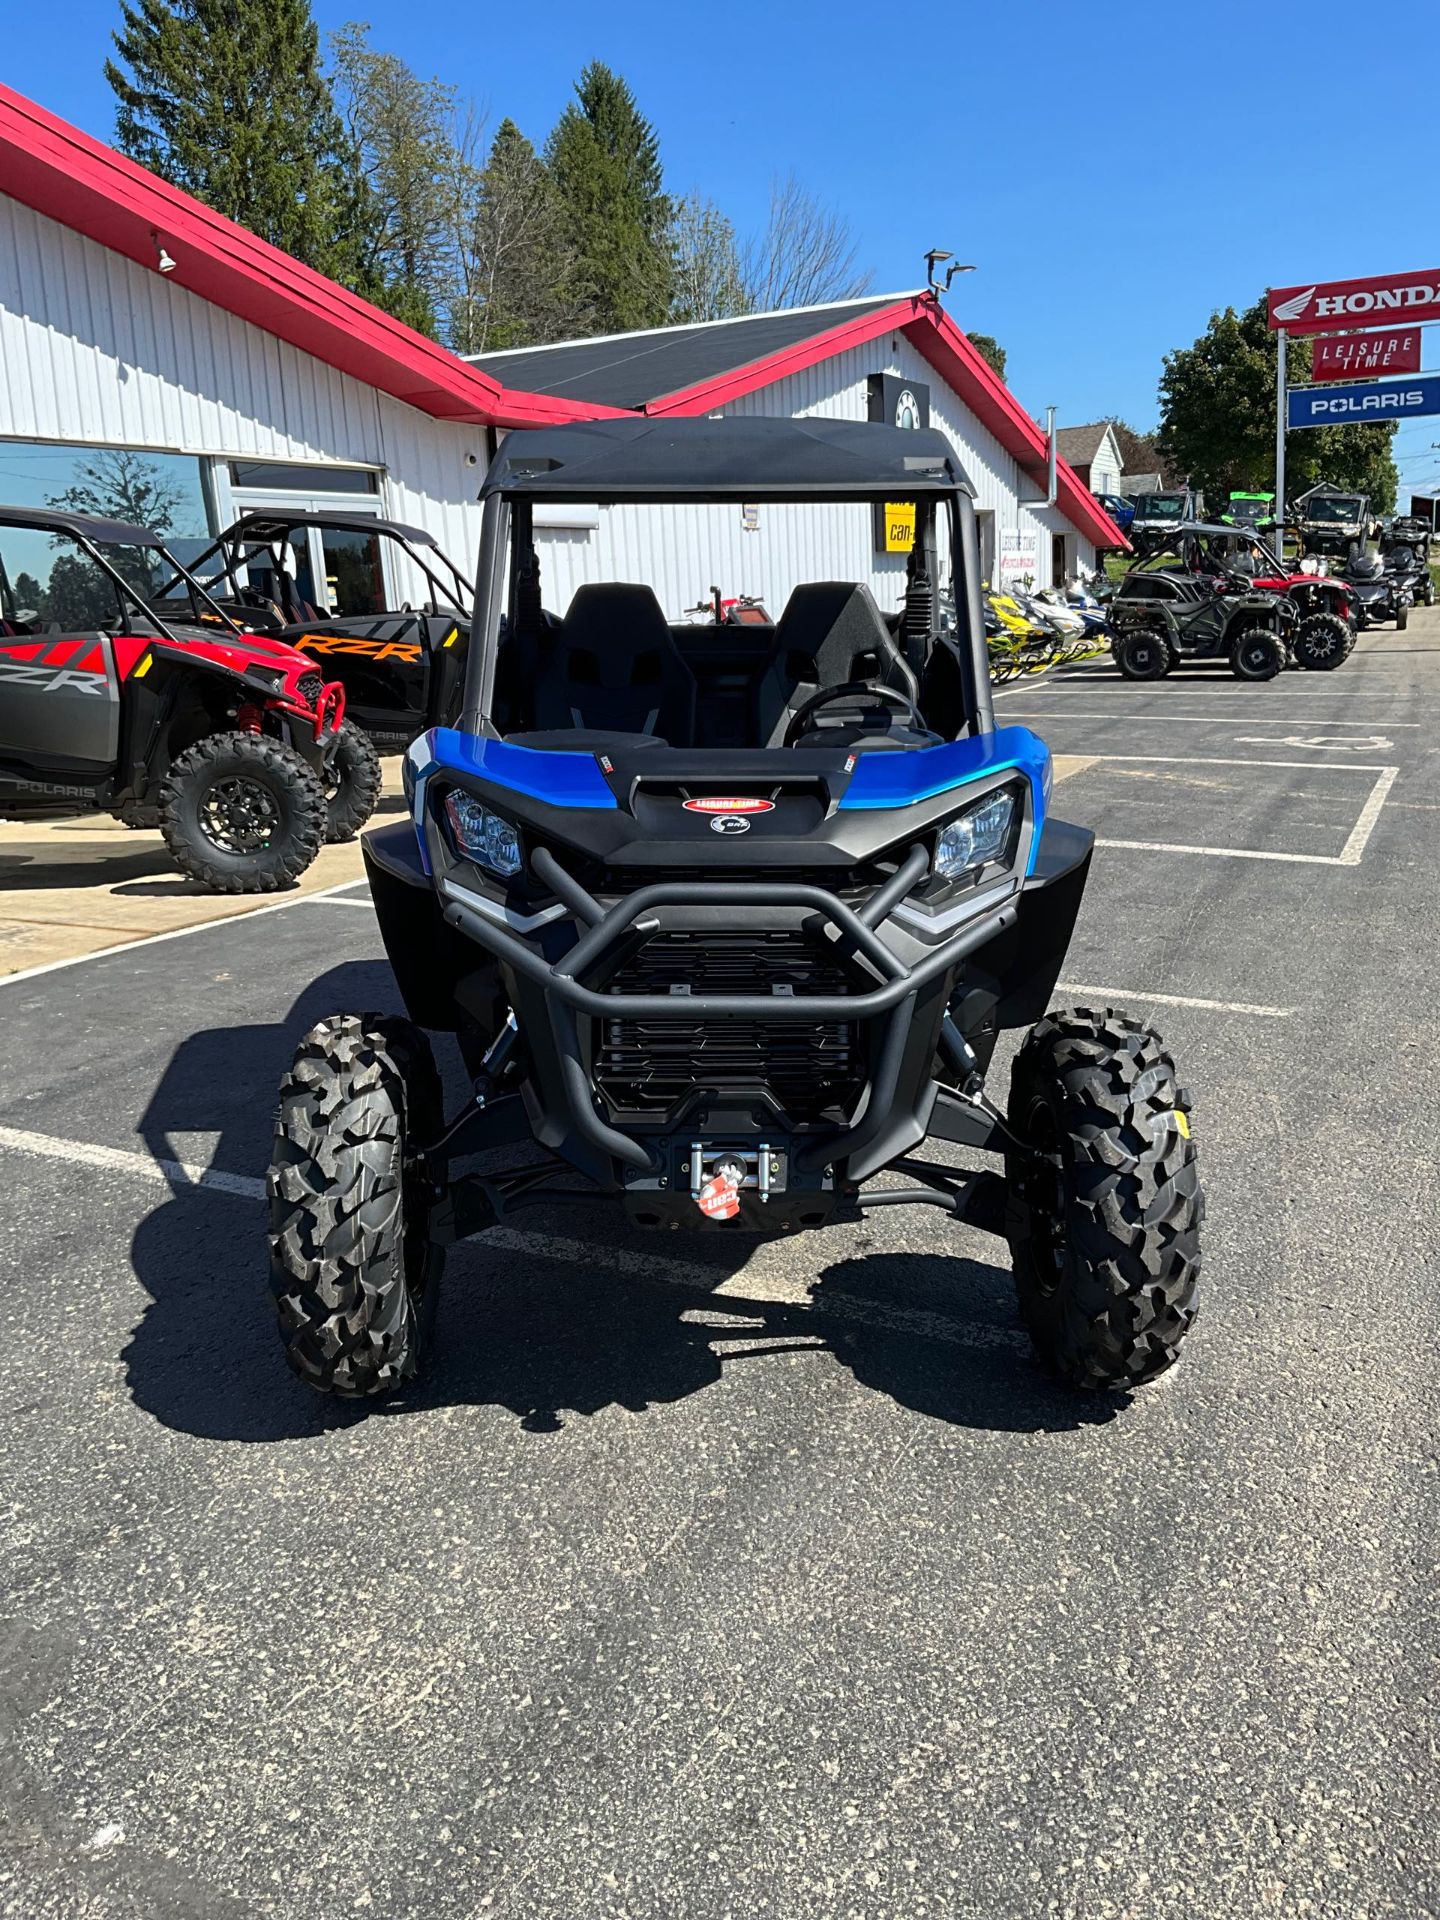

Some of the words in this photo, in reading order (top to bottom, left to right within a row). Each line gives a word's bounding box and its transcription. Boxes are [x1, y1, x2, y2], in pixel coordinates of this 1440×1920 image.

[1315, 284, 1440, 317] HOND
[1322, 337, 1412, 360] LEISURE
[1342, 352, 1392, 370] TIME
[1311, 391, 1424, 415] POLARIS
[294, 634, 423, 663] RZR
[0, 663, 108, 695] ZR
[364, 730, 409, 741] LARIS
[16, 783, 96, 798] POLARIS
[695, 799, 733, 809] LEISURE
